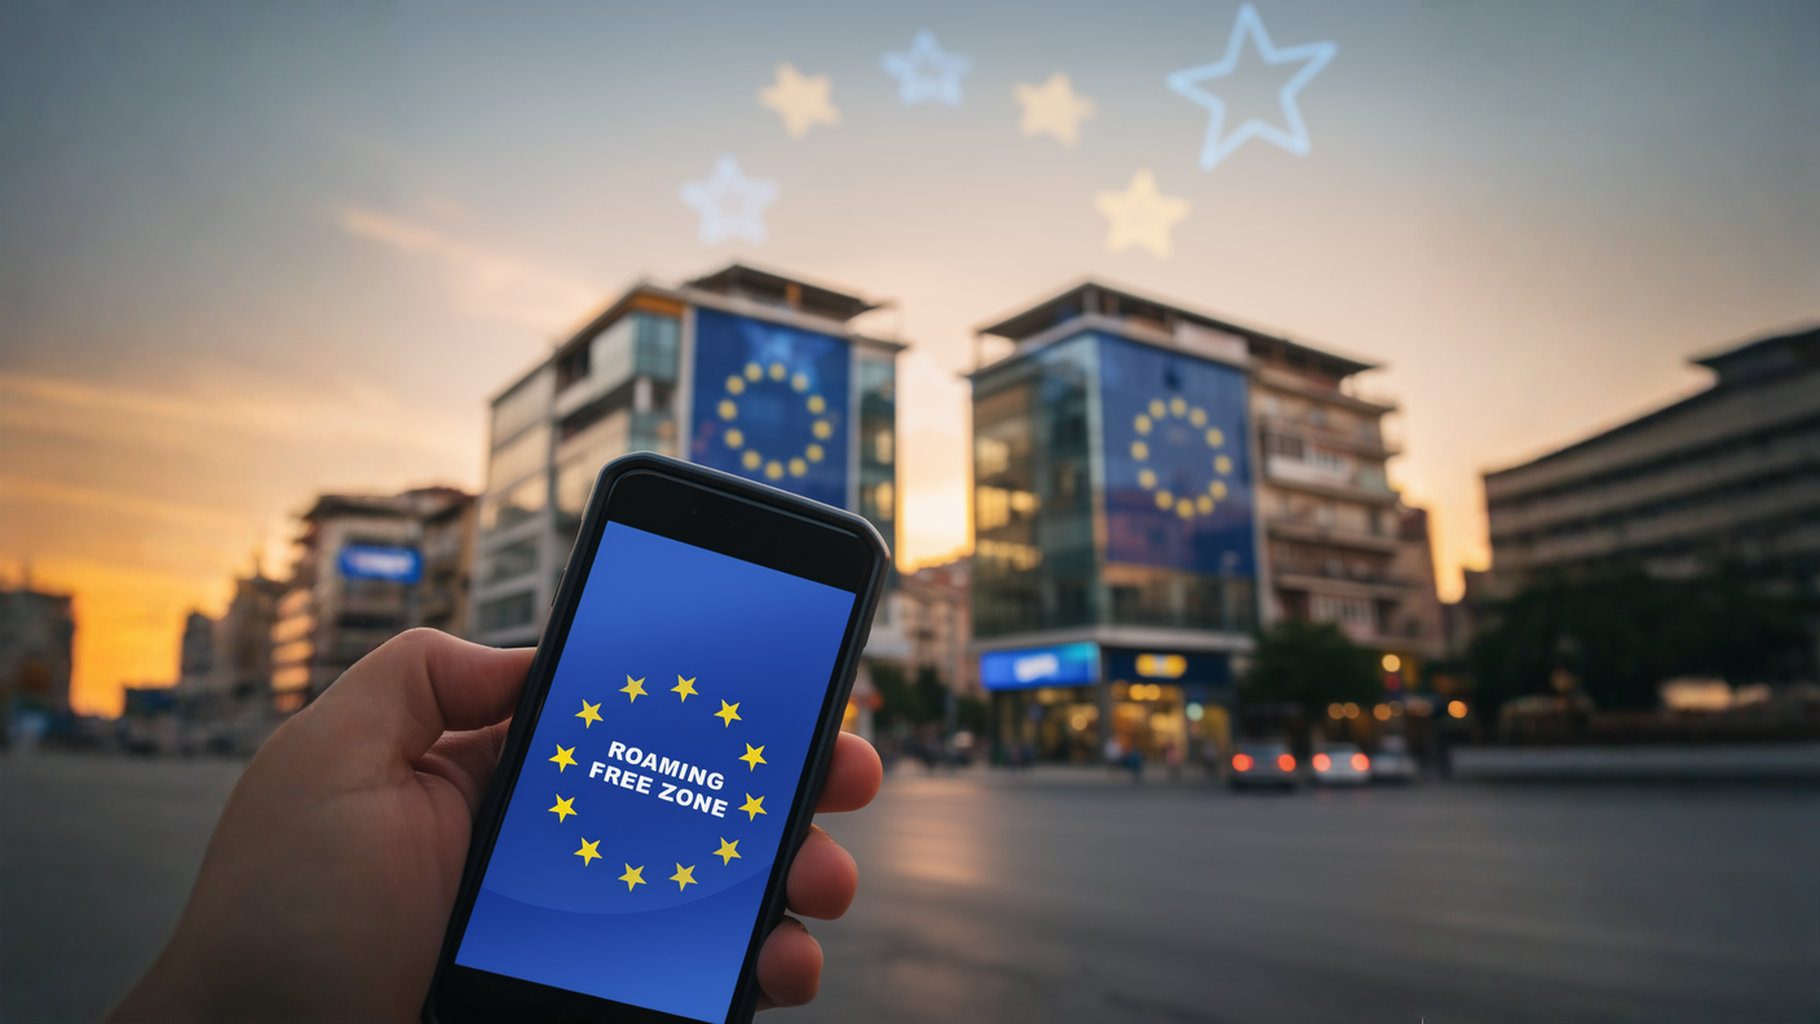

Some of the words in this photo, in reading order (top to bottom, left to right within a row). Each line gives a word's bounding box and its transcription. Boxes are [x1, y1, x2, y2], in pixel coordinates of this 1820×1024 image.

[588, 761, 654, 795] FREE
[657, 782, 729, 818] ZONE
[607, 740, 725, 791] ROAMING
